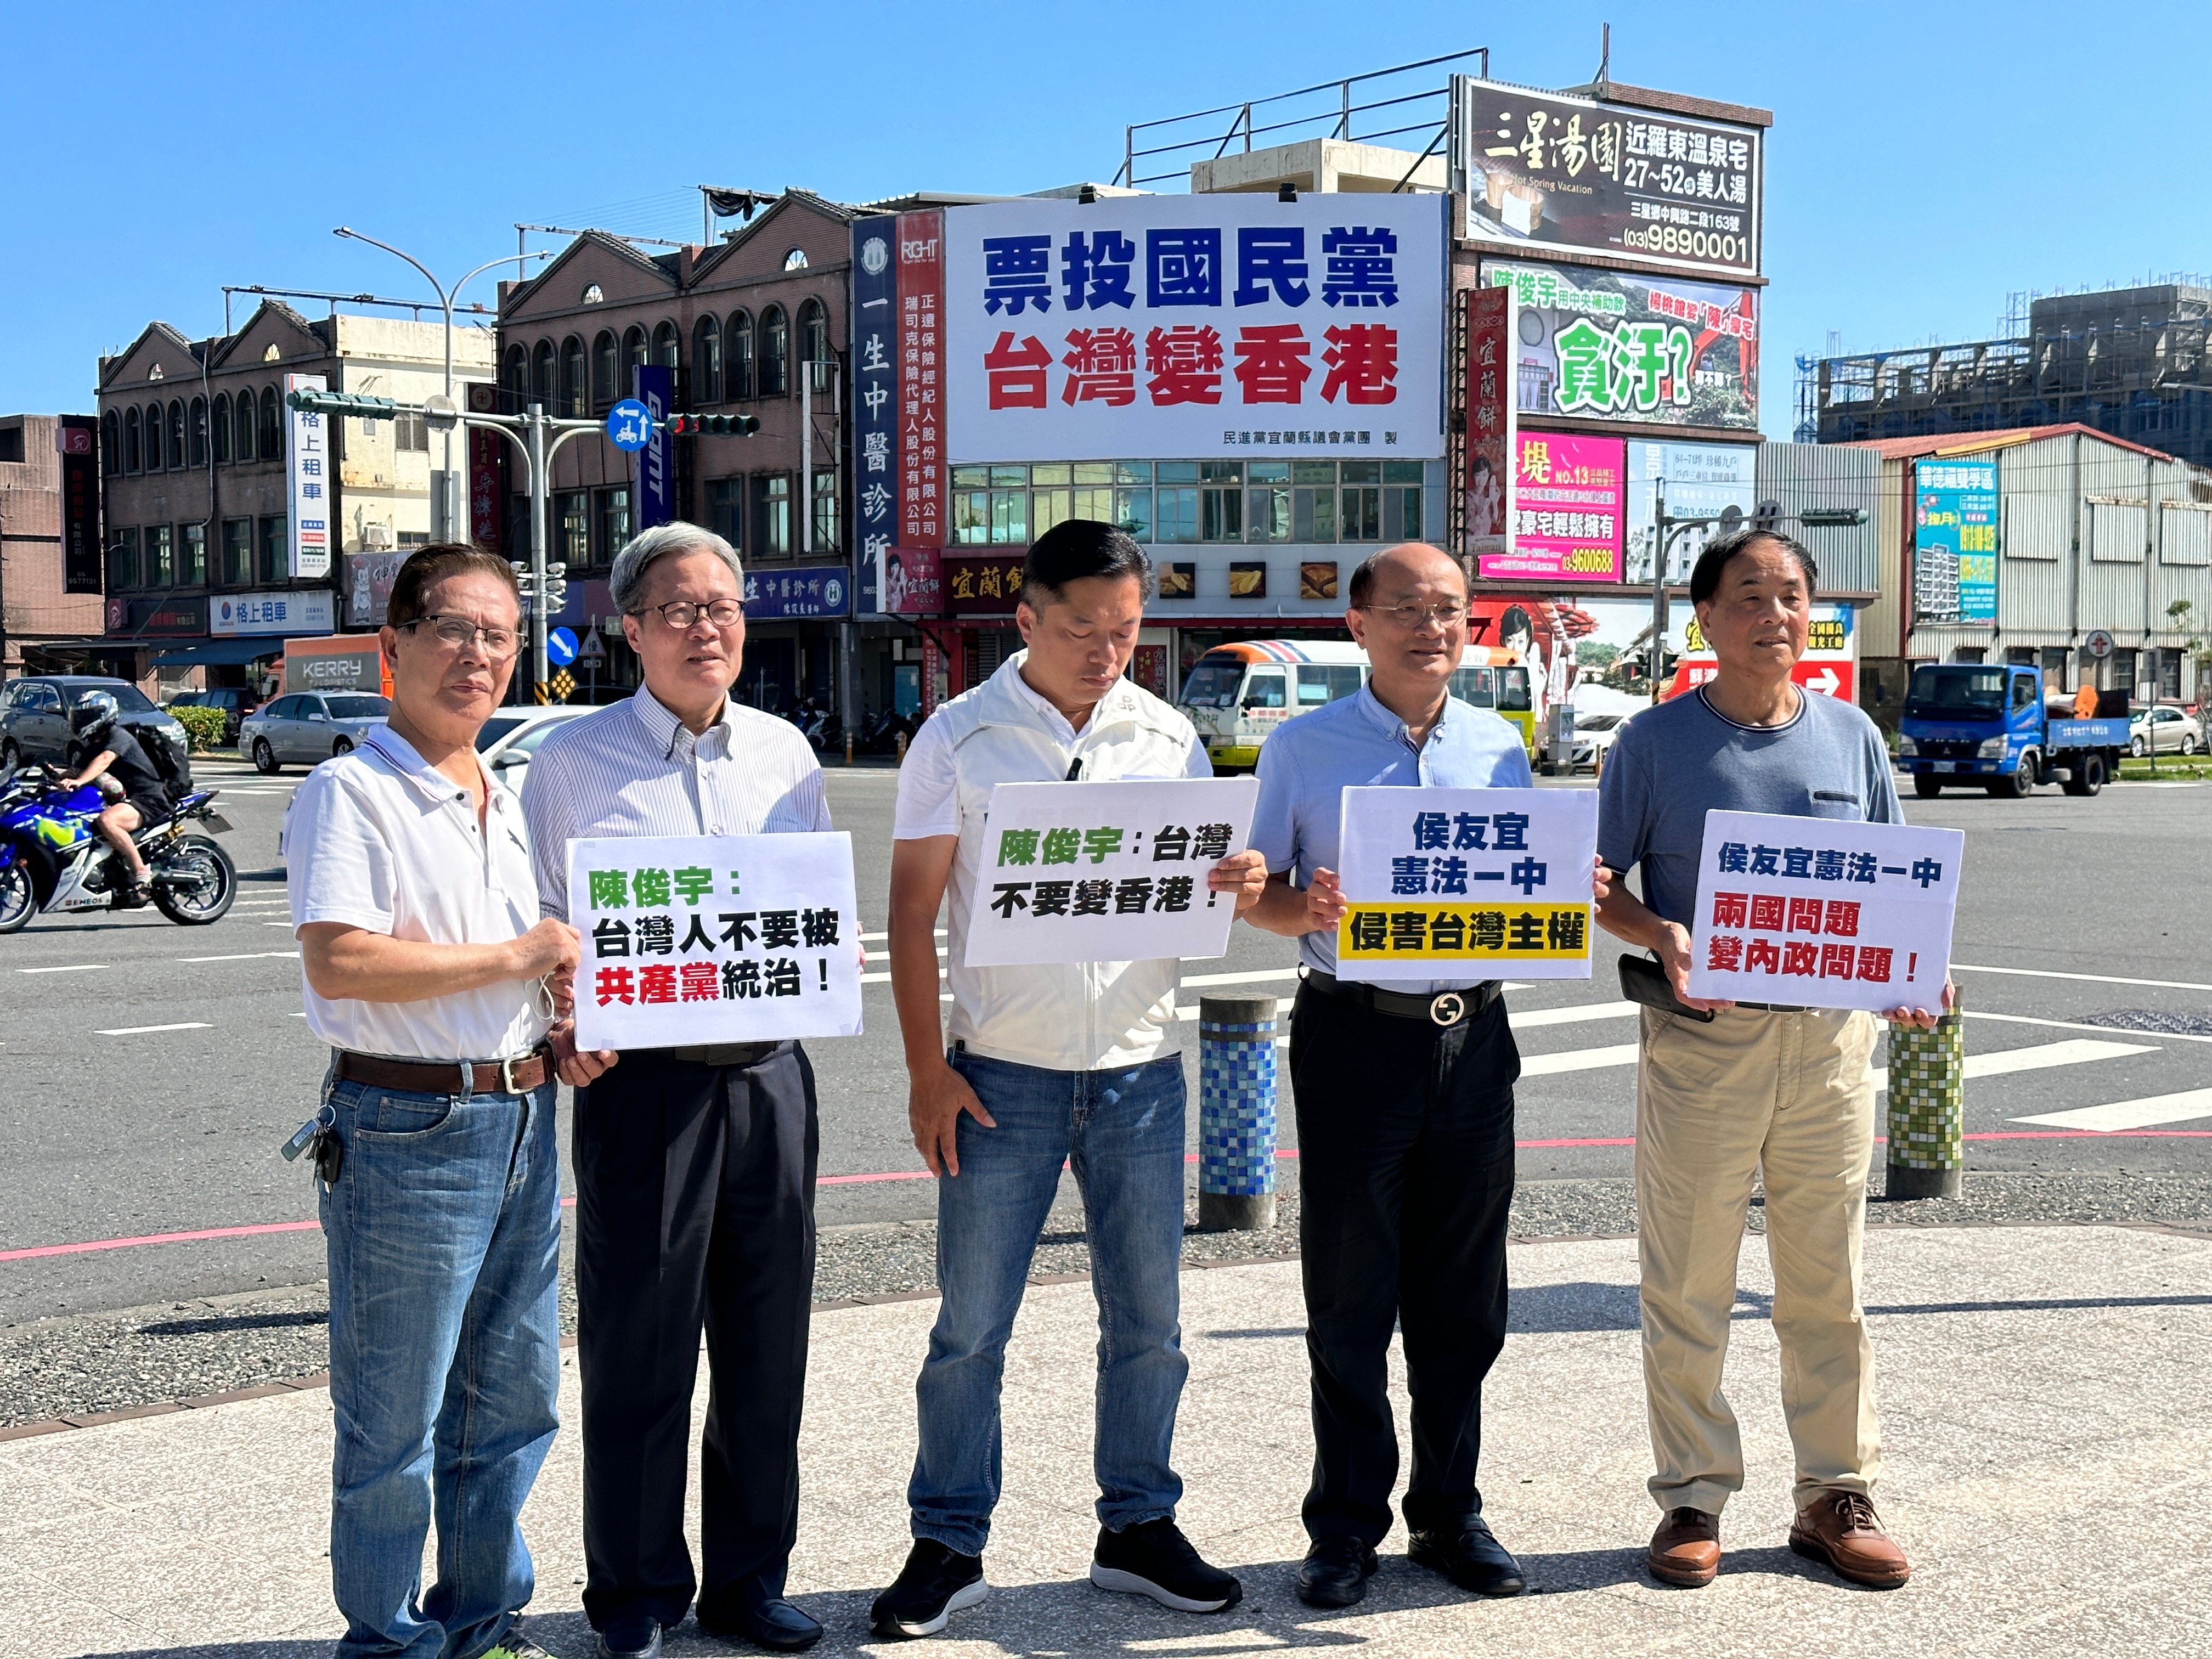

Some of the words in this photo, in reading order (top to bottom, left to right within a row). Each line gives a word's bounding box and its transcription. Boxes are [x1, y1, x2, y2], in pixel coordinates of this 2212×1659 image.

[1626, 121, 1748, 171] 近羅東溫泉宅
[1528, 176, 1555, 191] Spring
[1557, 181, 1593, 195] Vacation
[1624, 224, 1746, 263] (03)9890001
[983, 226, 1398, 317] 票投國民黨
[983, 324, 1398, 410] 台灣變香港
[1477, 337, 1497, 433] 宜蘭餅
[861, 298, 892, 566] 一生中醫診所
[905, 297, 919, 536] 瑞司克保險代理人股份有限公司
[921, 294, 936, 535] 正遠保險經紀人股份有限公司
[301, 411, 323, 500] 格上租車
[1223, 431, 1370, 445] 民進黨宜蘭縣議會黨團
[1384, 431, 1397, 445] 製
[1516, 440, 1551, 484] 堤
[1562, 548, 1613, 574] 03-9600688
[745, 577, 820, 601] 生中醫診所
[863, 585, 877, 595] 960
[236, 601, 287, 624] 格上租車
[1808, 620, 1844, 635] 全國優良
[588, 640, 597, 652] 慢
[1808, 635, 1844, 650] 觀光工廠
[303, 659, 362, 678] KERRY
[997, 823, 1233, 867] 陳俊宇：台灣
[1412, 811, 1530, 851] 侯友宜
[1391, 855, 1548, 895] 憲法一中
[1718, 842, 1942, 888] 侯友宜憲法一中
[588, 866, 740, 910] 陳俊宇：
[592, 907, 840, 958] 台灣人不要被
[1349, 911, 1585, 951] 侵害台灣主權
[1712, 891, 1862, 937] 兩國問題
[1707, 935, 1917, 984] 變內政問題！
[595, 957, 828, 1007] 共產黨統治！
